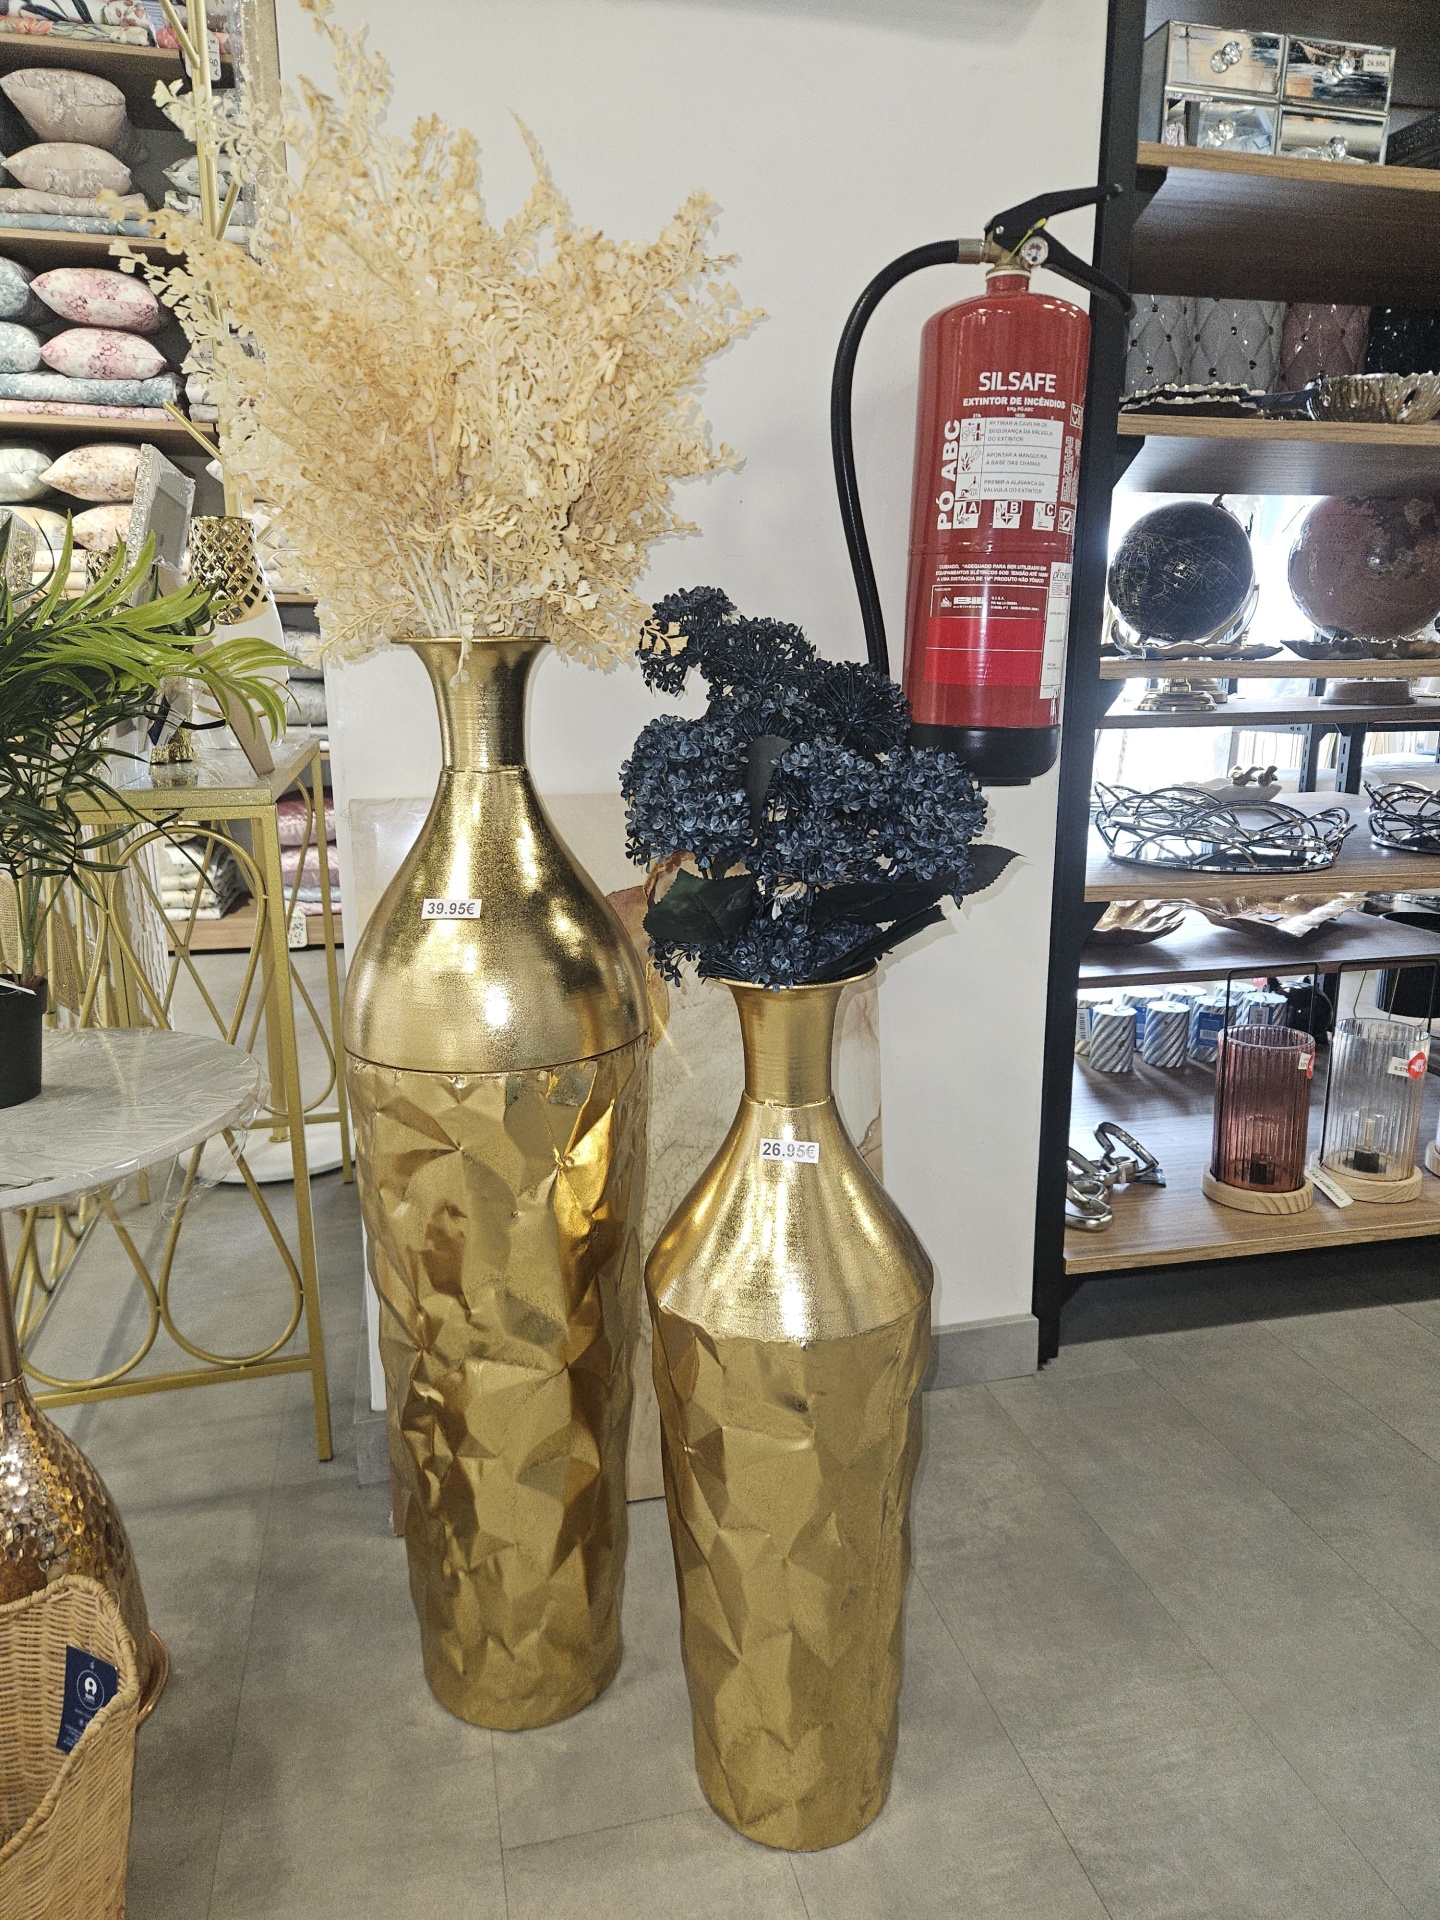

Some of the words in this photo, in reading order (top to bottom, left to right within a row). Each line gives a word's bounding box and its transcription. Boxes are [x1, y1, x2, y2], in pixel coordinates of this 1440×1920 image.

[978, 371, 1057, 393] SILSAFE
[963, 396, 1008, 407] EXTINTOR
[1010, 396, 1022, 405] DE
[1024, 396, 1066, 409] INCÊNDIOS
[941, 419, 960, 482] ABC
[936, 491, 955, 530] PÓ
[968, 501, 978, 514] A
[1010, 502, 1019, 513] B
[1046, 504, 1055, 516] C
[427, 902, 475, 914] 39.95€
[762, 1142, 815, 1159] 26.95€
